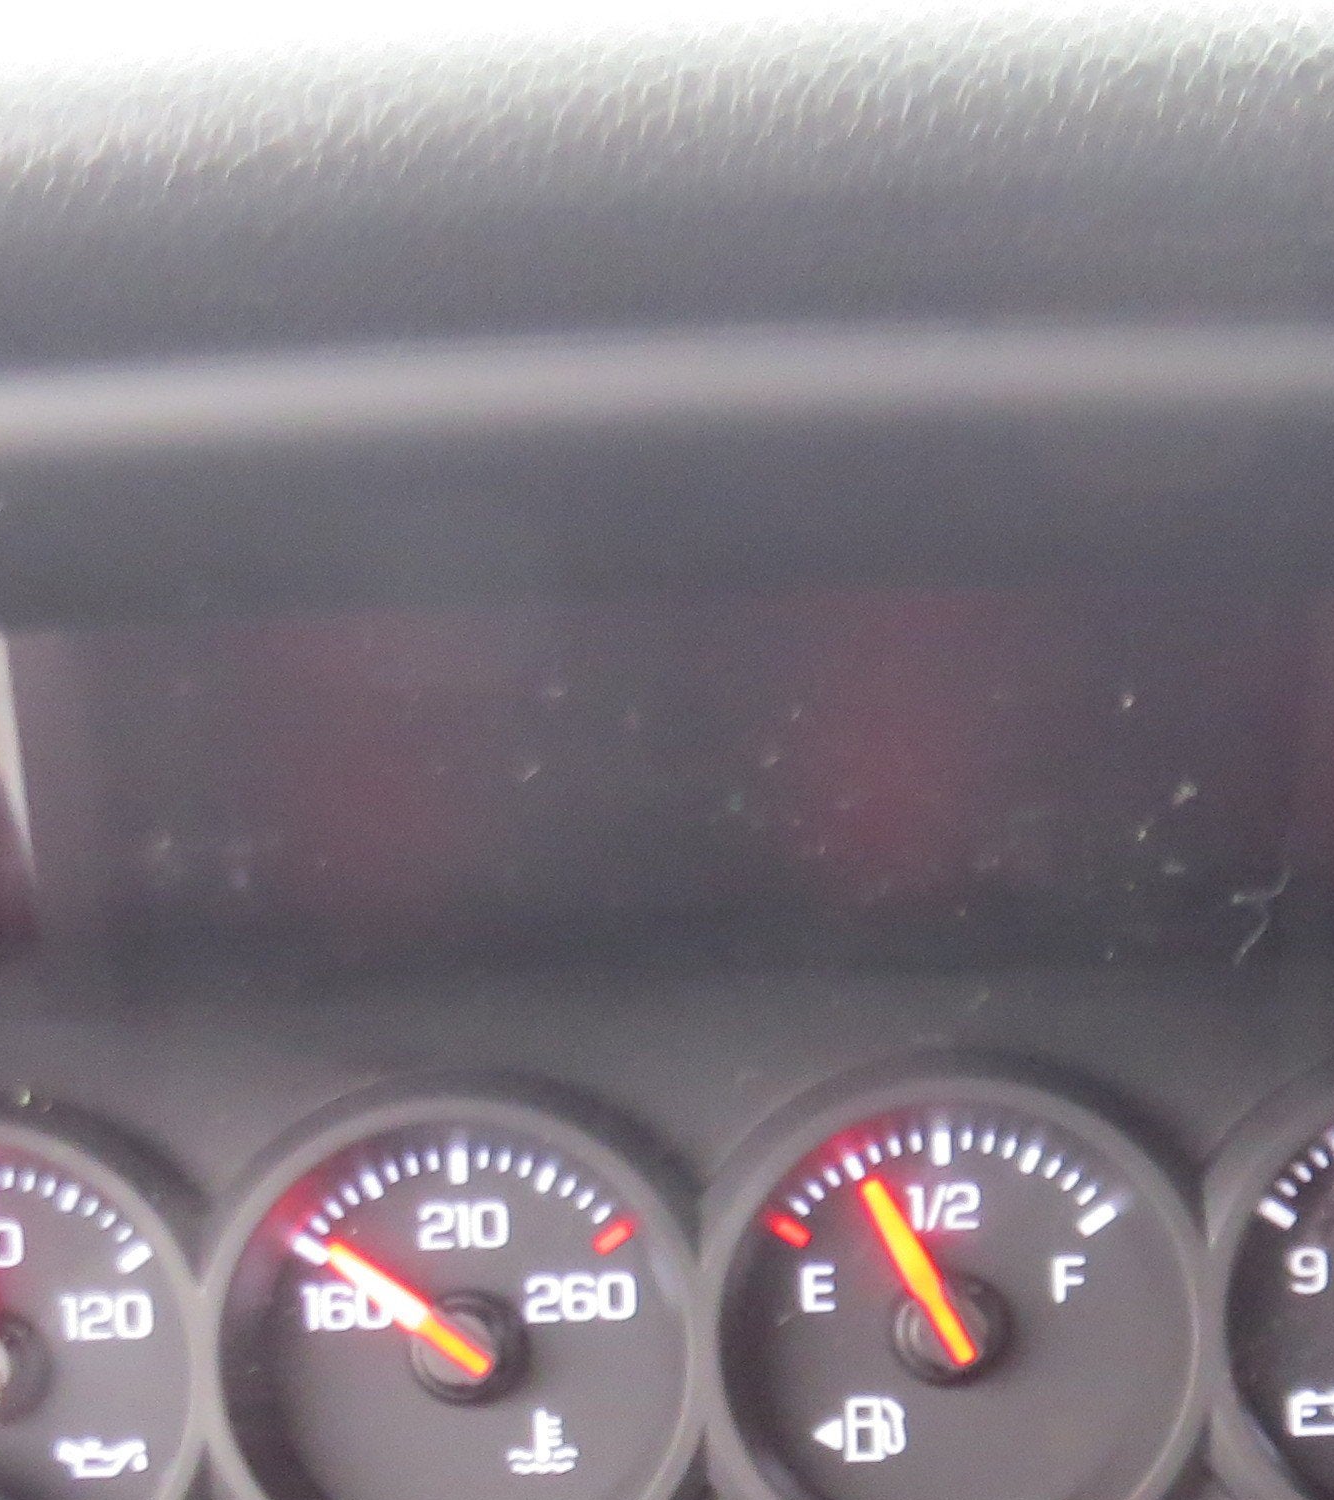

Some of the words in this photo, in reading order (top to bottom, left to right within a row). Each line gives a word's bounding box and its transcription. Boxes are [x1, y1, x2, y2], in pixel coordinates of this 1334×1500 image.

[418, 1202, 509, 1251] 210
[906, 1183, 980, 1231] 1/2
[801, 1263, 836, 1312] E
[1052, 1255, 1085, 1302] F
[1288, 1247, 1328, 1295] 9
[61, 1292, 153, 1341] 120
[303, 1282, 394, 1331] 160
[524, 1273, 637, 1322] 260
